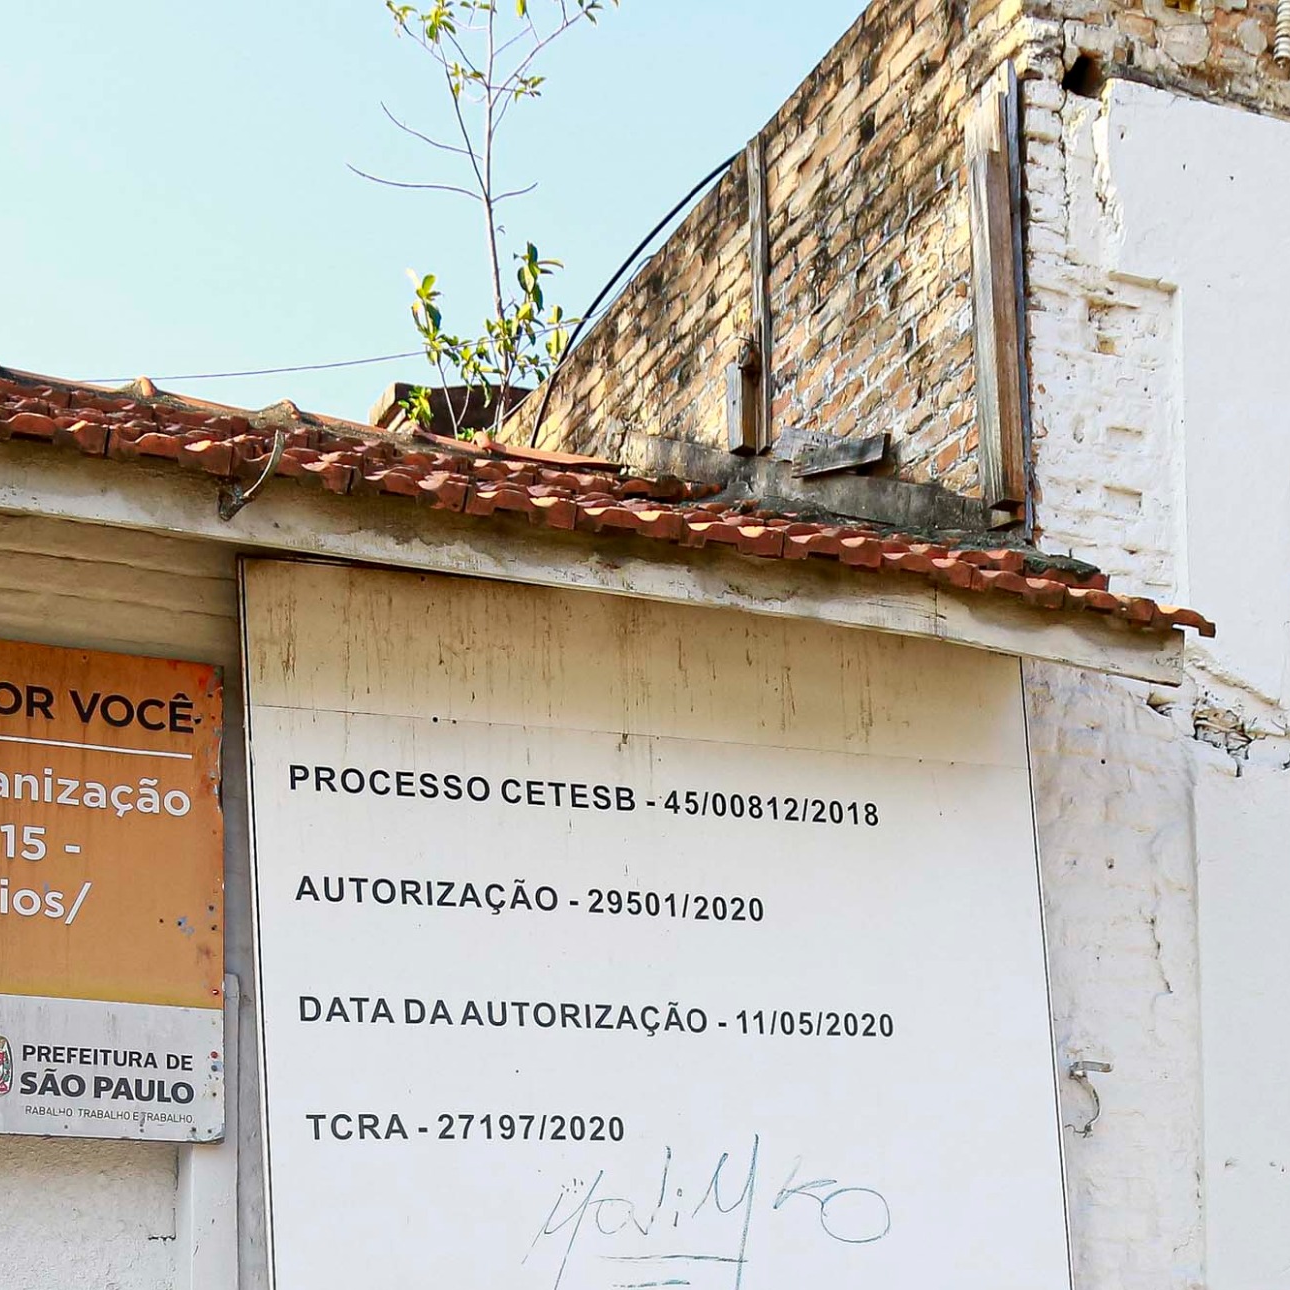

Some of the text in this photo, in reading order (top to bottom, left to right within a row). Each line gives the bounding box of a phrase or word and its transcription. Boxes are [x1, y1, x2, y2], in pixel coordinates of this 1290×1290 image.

[68, 690, 195, 735] VOCÊ
[289, 764, 490, 807] PROCESSO
[501, 778, 636, 811] CETESB
[664, 790, 879, 827] 45/00812/2018
[0, 824, 47, 862] 15
[64, 844, 82, 854] -
[295, 876, 558, 915] AUTORIZAÇÃO
[588, 889, 765, 922] 29501/2020
[299, 996, 395, 1024] DATA
[404, 998, 454, 1025] DA
[460, 1000, 708, 1036] AUTORIZAÇÃO
[736, 1010, 894, 1038] 11/05/2020
[22, 1043, 193, 1071] PREFEITURA DE
[20, 1067, 195, 1105] SÃO PAULO
[78, 1108, 131, 1121] TRABALHO
[133, 1112, 139, 1121] E
[305, 1113, 409, 1140] TCRA
[438, 1113, 625, 1142] 27197/2020
